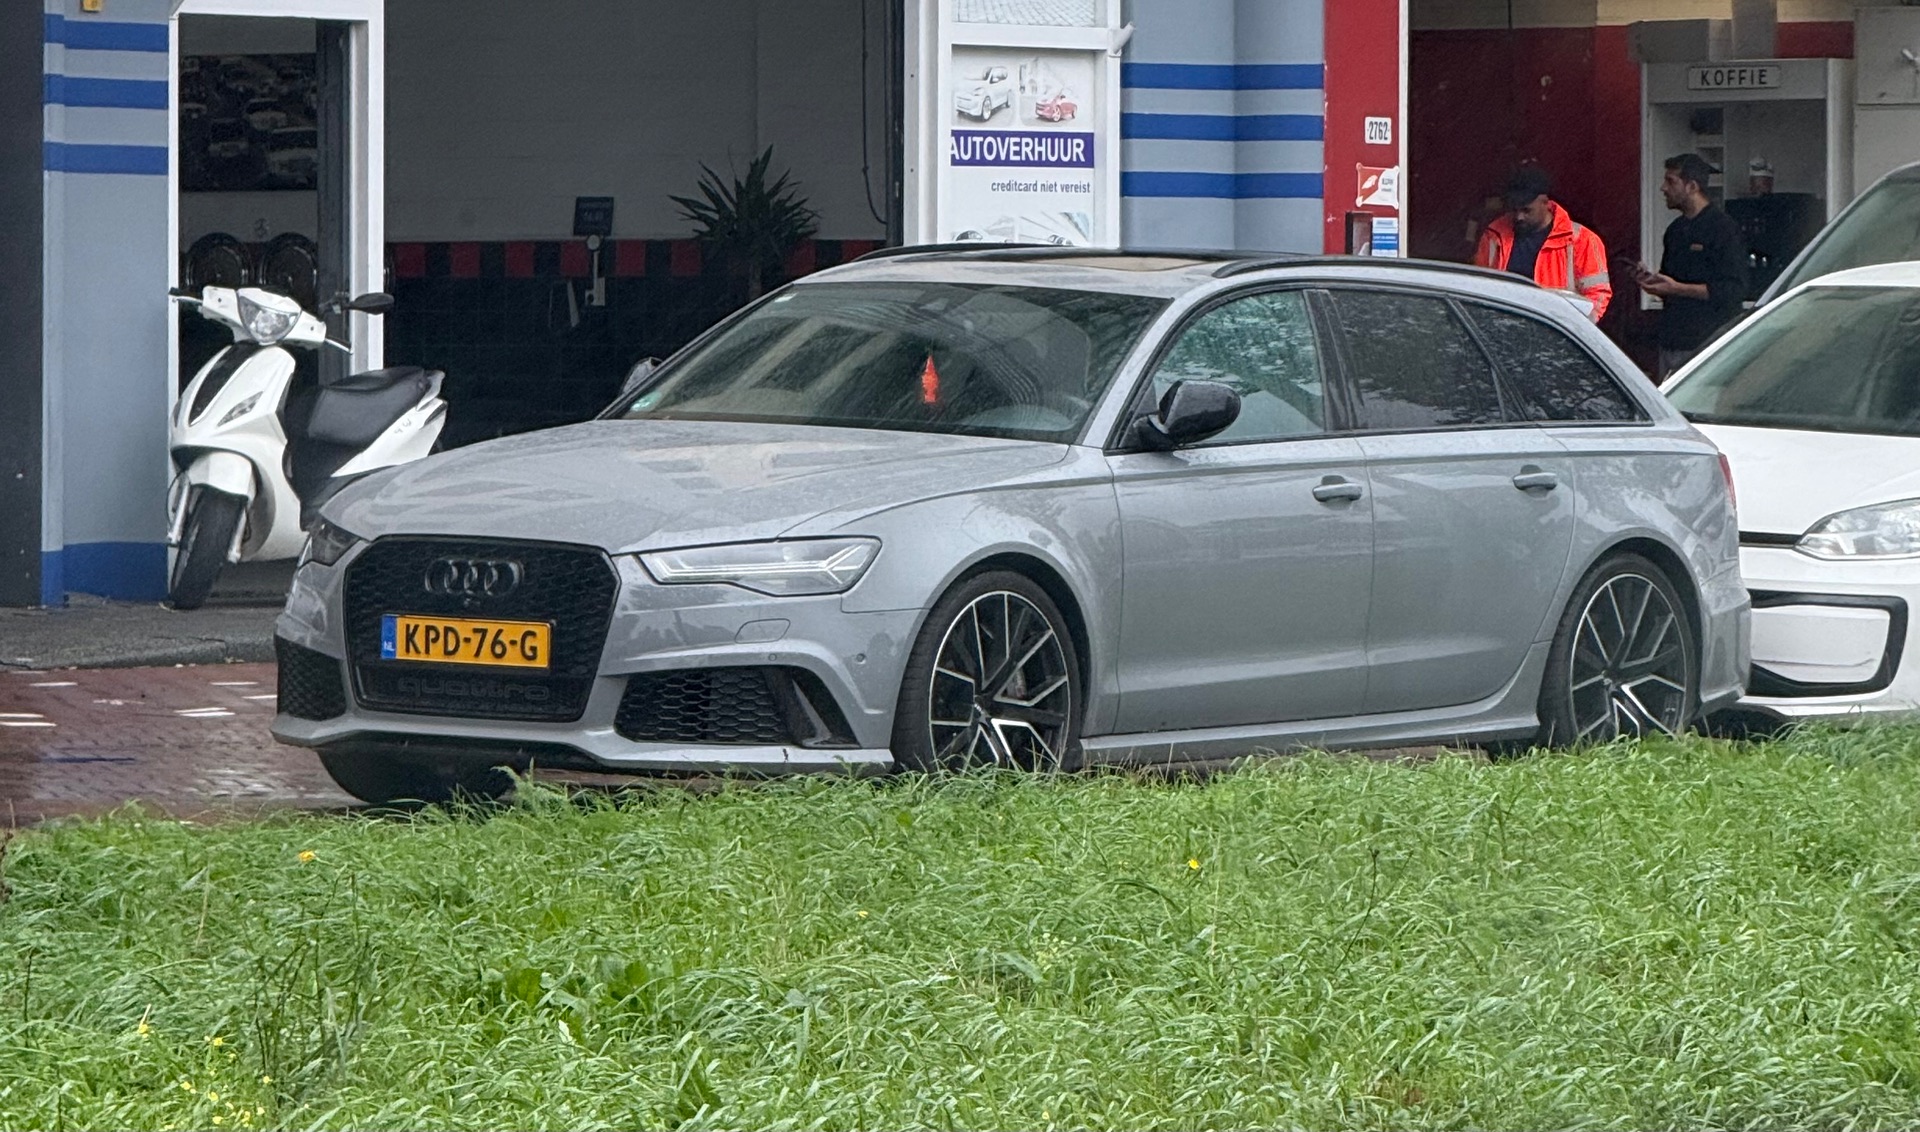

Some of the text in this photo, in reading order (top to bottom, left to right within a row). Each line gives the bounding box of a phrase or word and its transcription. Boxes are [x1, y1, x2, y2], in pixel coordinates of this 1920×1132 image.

[1700, 68, 1768, 86] KOFFIE
[1368, 121, 1388, 141] 2762
[950, 135, 1086, 163] AUTOVERHUUR
[991, 180, 1091, 193] creditcard niet vereist
[404, 623, 539, 661] KPD-76-G
[398, 677, 550, 701] quattro
